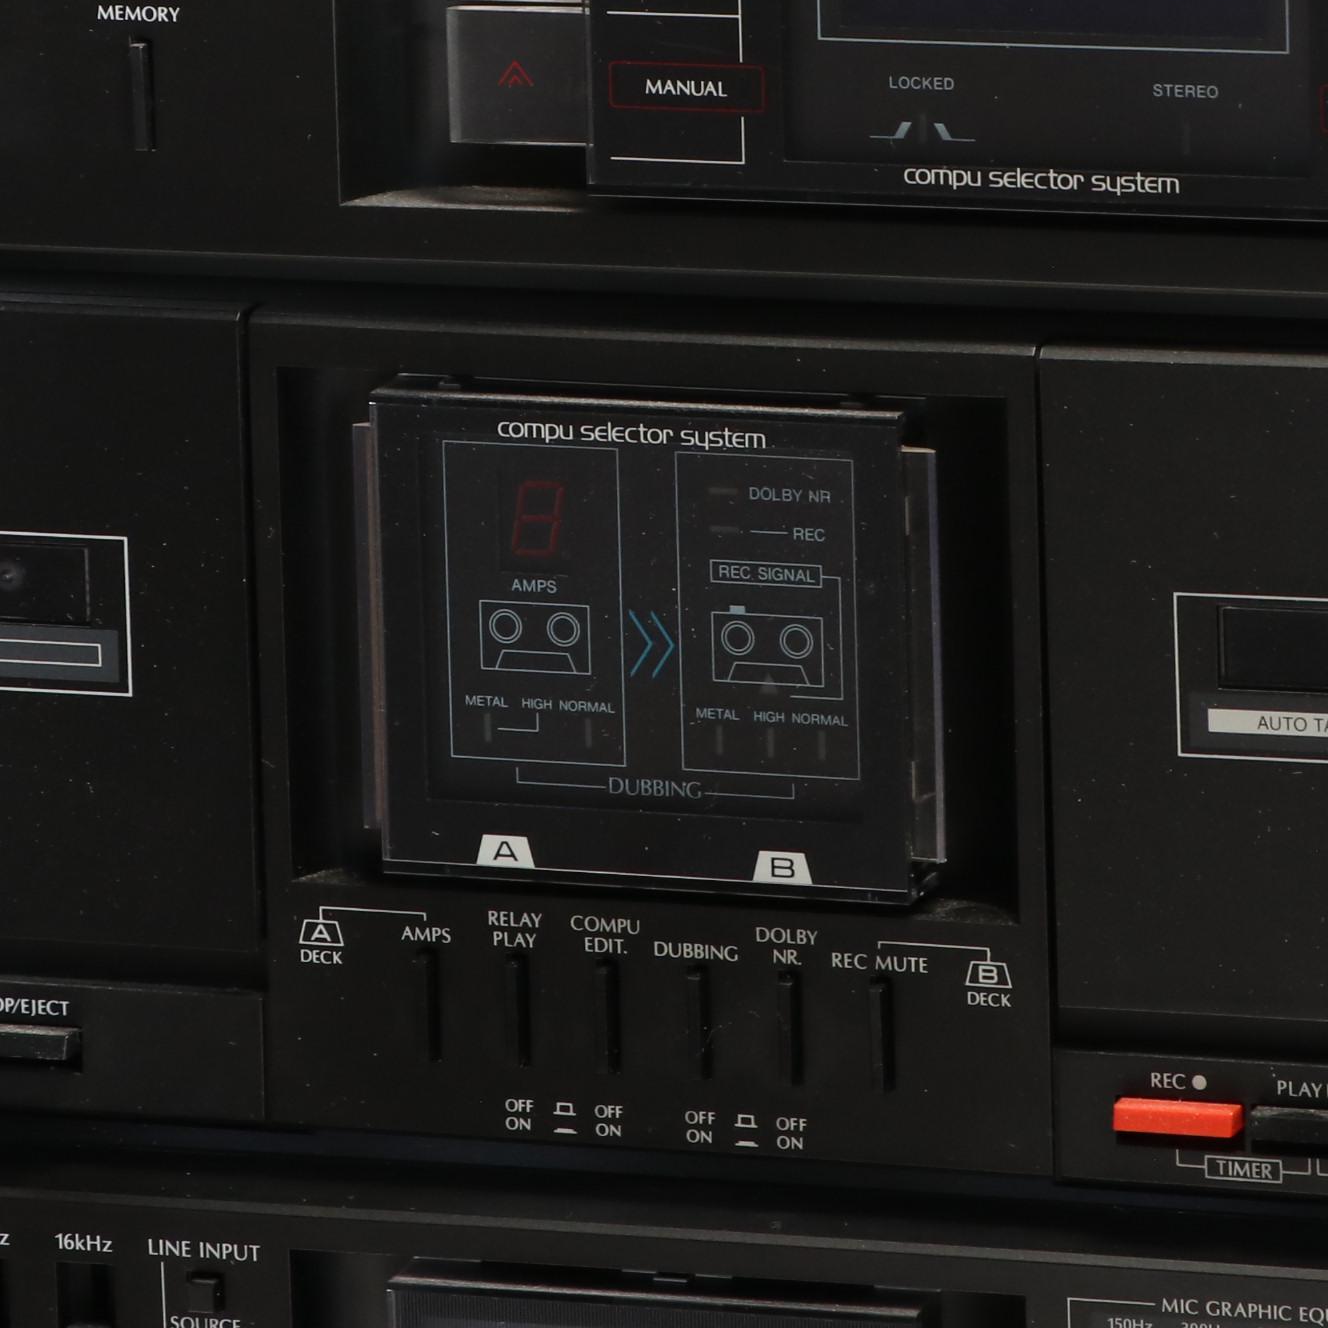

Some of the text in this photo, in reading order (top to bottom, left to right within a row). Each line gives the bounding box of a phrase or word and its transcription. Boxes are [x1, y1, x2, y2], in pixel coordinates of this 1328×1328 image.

[97, 4, 180, 23] MEMORY
[645, 78, 728, 97] MANUAL
[888, 75, 955, 91] LOCKED
[1152, 83, 1219, 99] STEREO
[903, 167, 1180, 196] compu selector system
[496, 421, 766, 451] compu selector system
[748, 486, 831, 504] DOLBY NR
[718, 564, 816, 583] REC SIGNAL
[511, 578, 558, 594] AMPS
[465, 694, 616, 714] METAL HIGH NORMAL
[1257, 715, 1308, 732] AUTO
[608, 776, 702, 799] DUBBING
[487, 910, 543, 928] RELAY
[570, 915, 640, 935] COMPU
[401, 925, 452, 944] AMPS
[492, 930, 537, 949] PLAY
[755, 926, 818, 945] DOLBY
[584, 936, 628, 955] EDIT.
[653, 940, 739, 962] DUBBING
[772, 948, 802, 966] NR.
[831, 952, 929, 974] REC MUTE
[1150, 1072, 1186, 1090] REC
[1277, 1079, 1323, 1098] PLAY
[1214, 1159, 1274, 1181] TIMER
[54, 1232, 113, 1253] 16kHz
[148, 1238, 261, 1262] LINE INPUT
[1161, 1297, 1199, 1315] MIC
[1205, 1300, 1292, 1322] GRAPHIC
